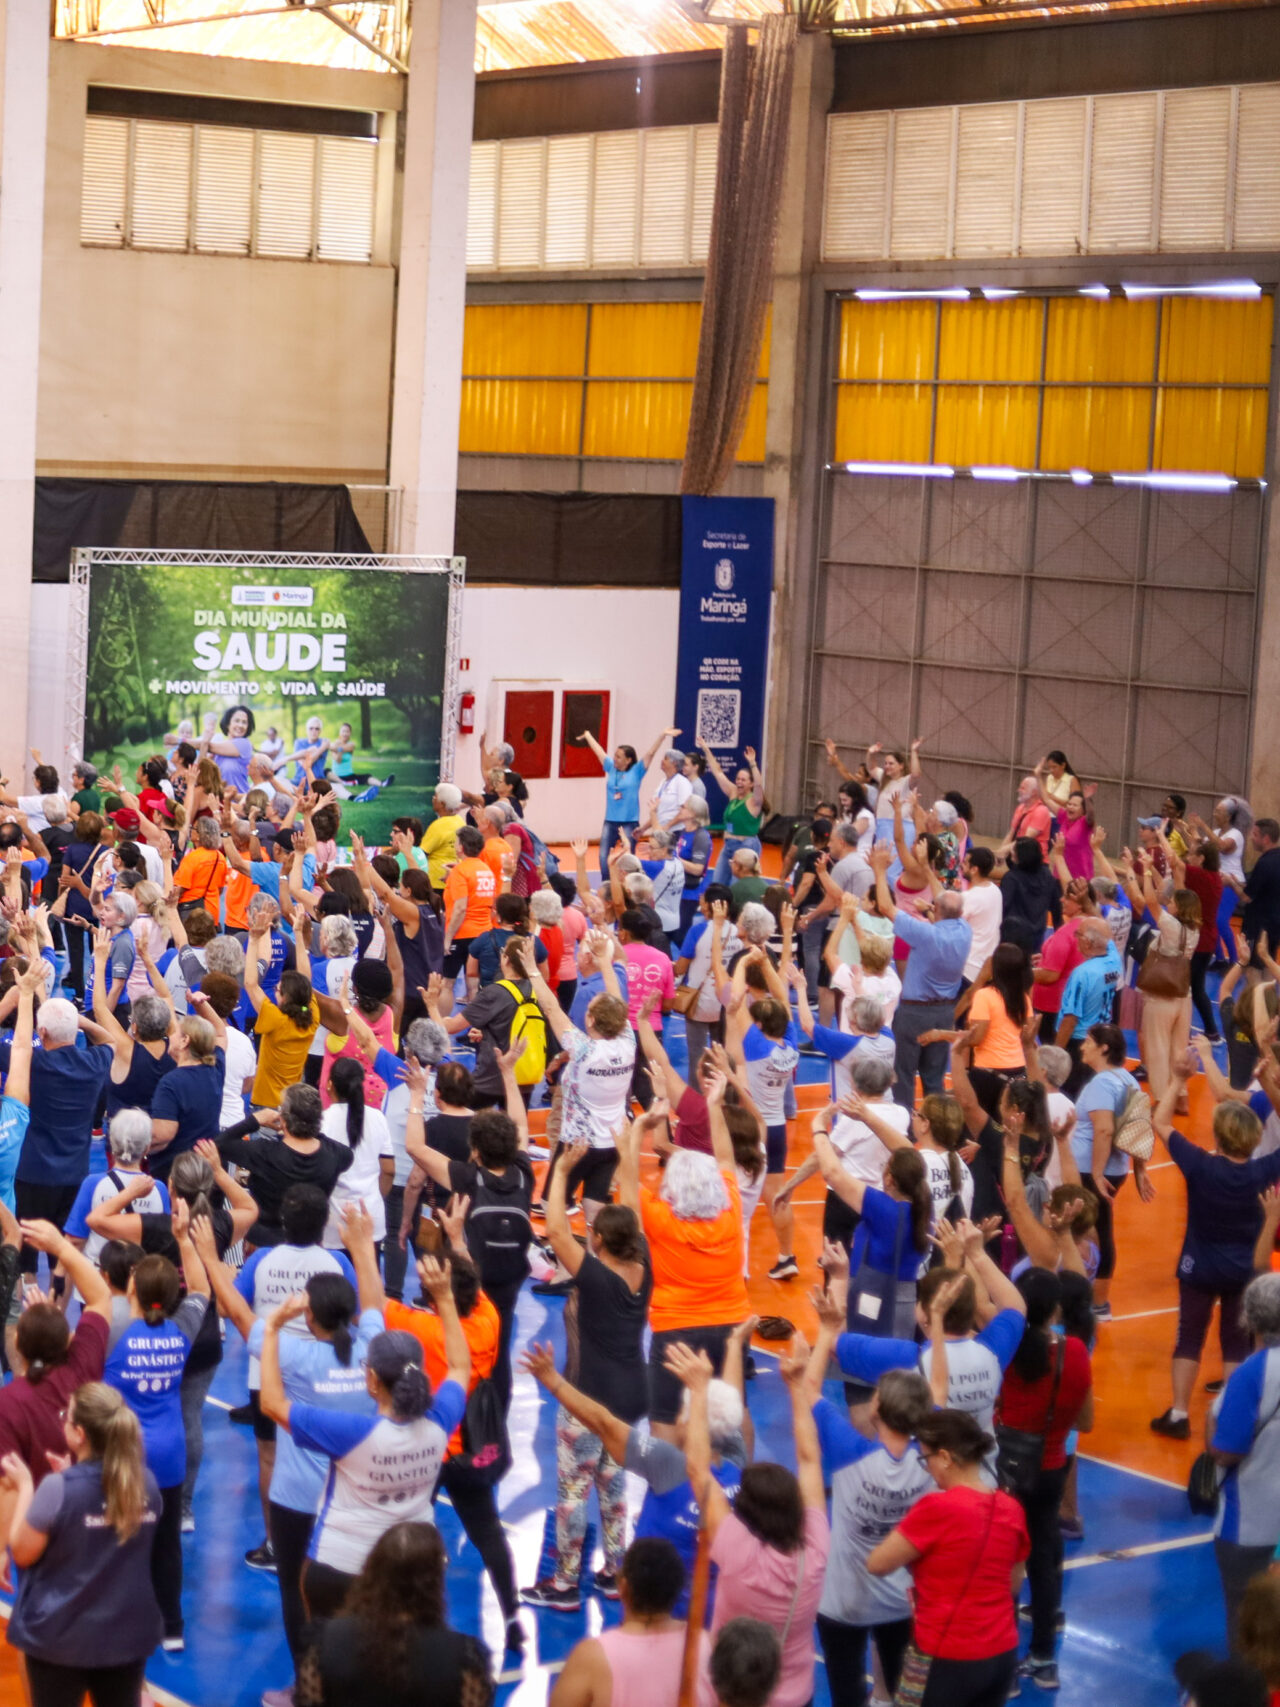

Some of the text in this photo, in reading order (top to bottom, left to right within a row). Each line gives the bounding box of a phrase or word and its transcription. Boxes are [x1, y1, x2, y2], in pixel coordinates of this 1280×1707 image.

[702, 539, 727, 550] Esporte
[732, 540, 750, 550] Lazer
[700, 597, 747, 618] Maringá
[194, 609, 347, 629] DIA MUNDIAL DA
[191, 621, 348, 673] SAÚDE
[703, 657, 713, 665] QR
[165, 680, 260, 695] MOVIMENTO
[279, 681, 317, 696] VIDA
[336, 679, 386, 697] SAÚDE
[127, 1337, 170, 1350] GRUPO
[127, 1352, 185, 1366] GINÁSTICA
[950, 1374, 977, 1386] UPO
[372, 1446, 438, 1466] GRUPO DE
